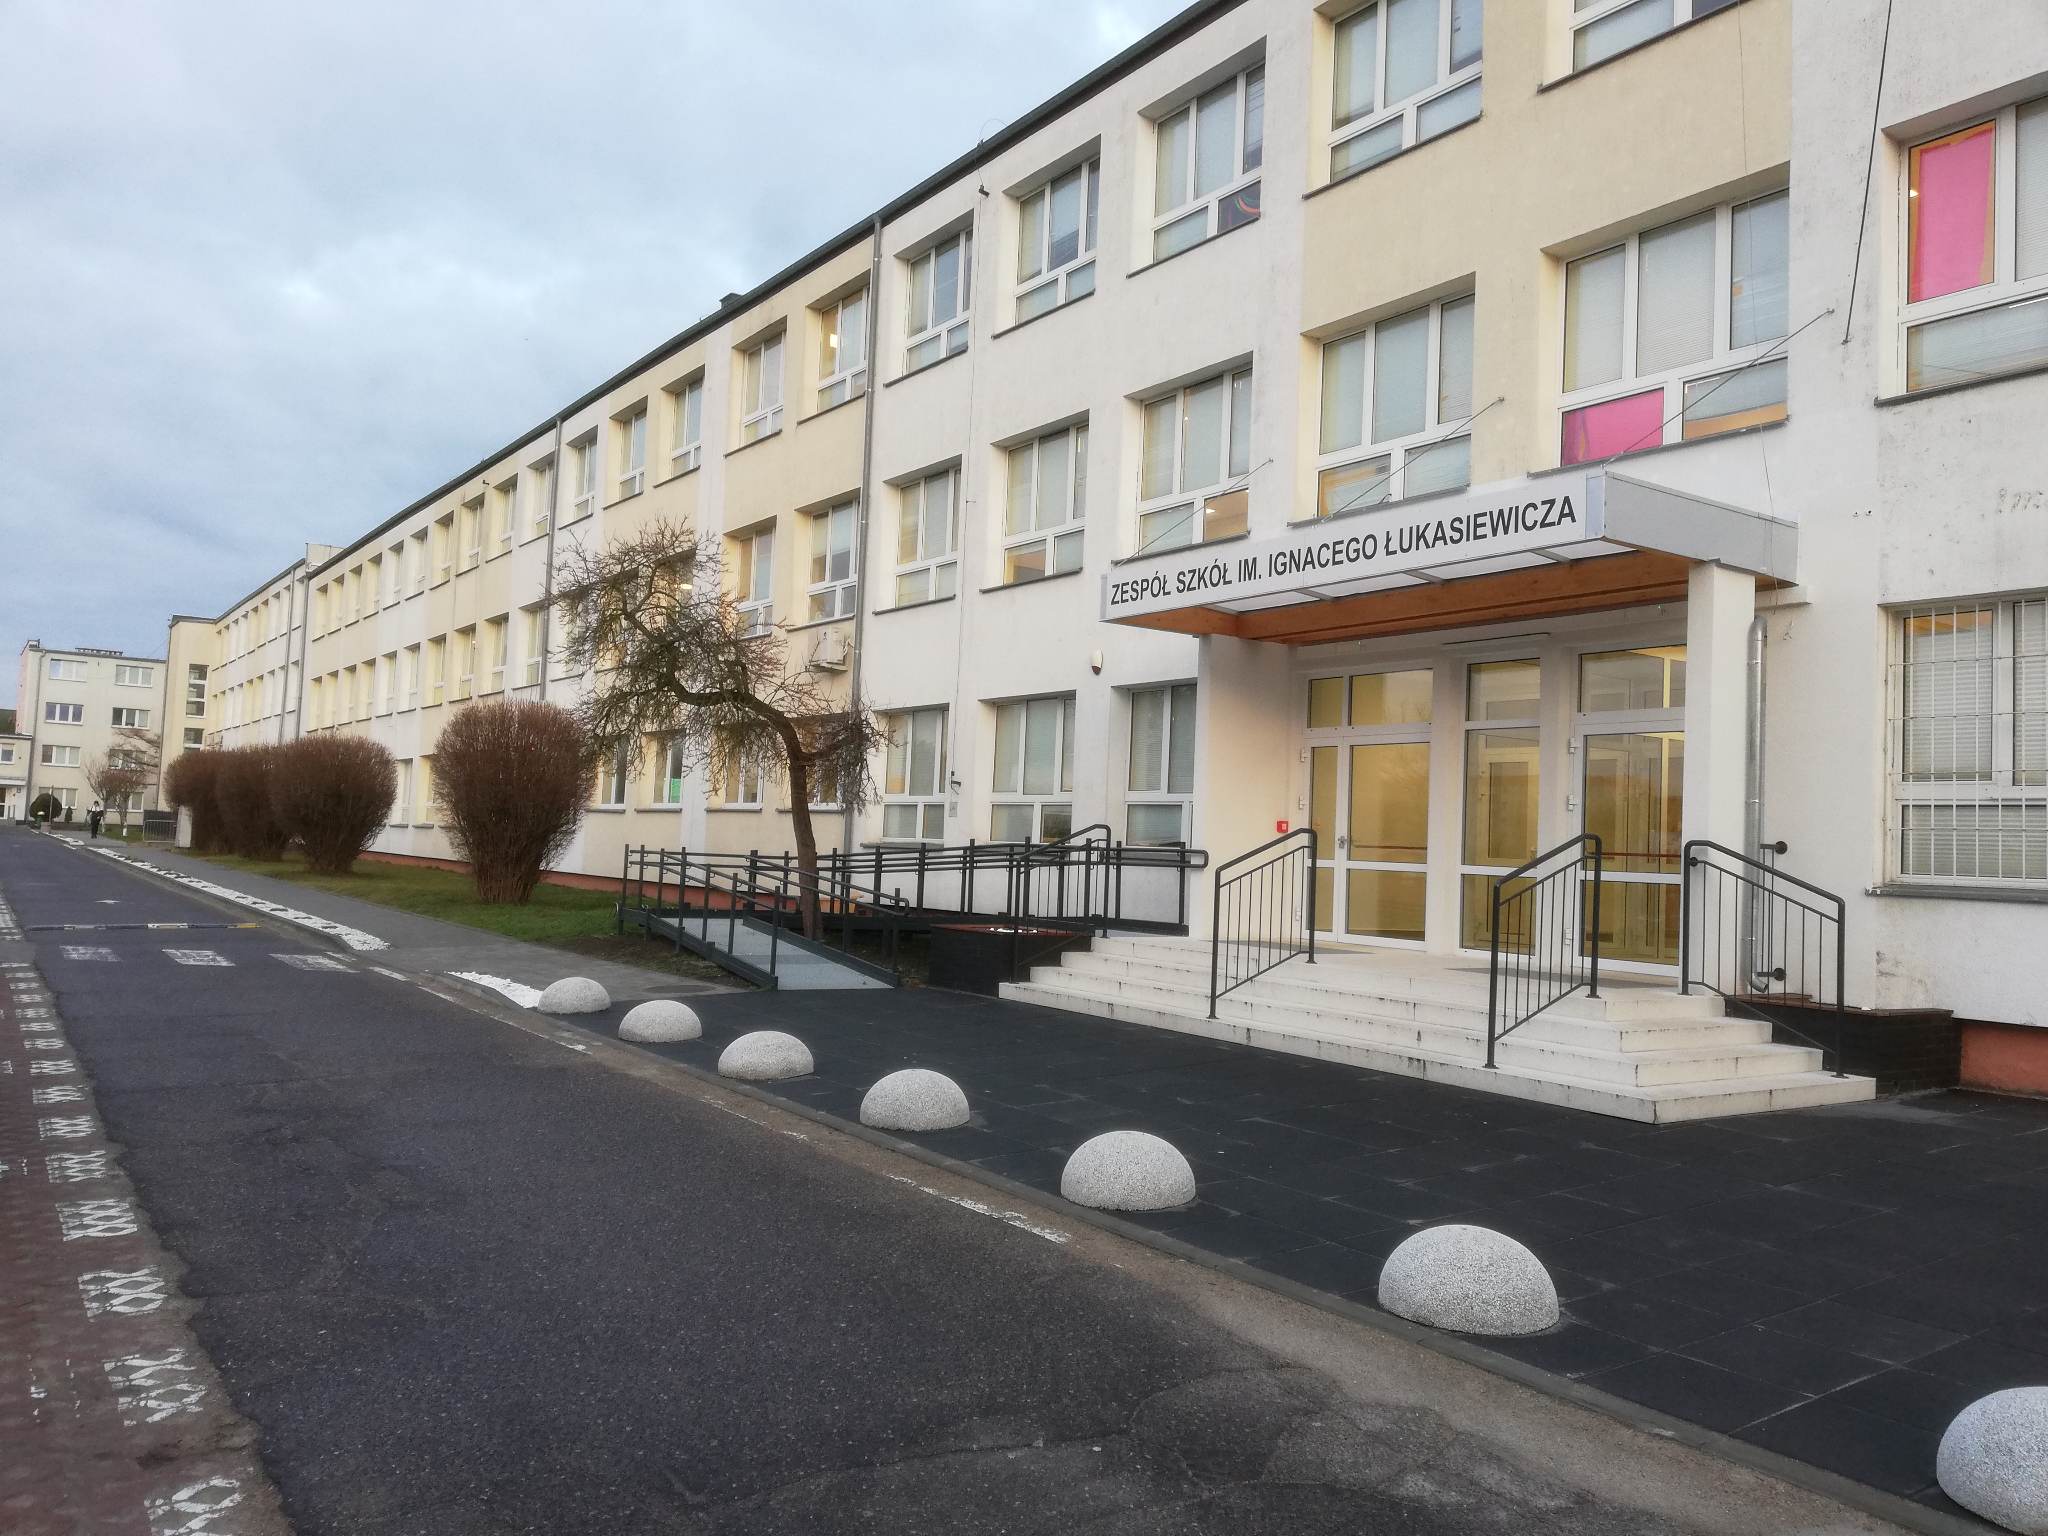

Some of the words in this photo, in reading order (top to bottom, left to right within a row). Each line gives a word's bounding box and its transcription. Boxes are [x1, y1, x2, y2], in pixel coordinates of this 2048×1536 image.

[1110, 570, 1172, 606] ZESPÓŁ
[1176, 558, 1233, 594] SZKÓŁ
[1238, 556, 1262, 583] IM.
[1268, 533, 1378, 578] IGNACEGO
[1383, 495, 1577, 557] ŁUKASIEWICZA
